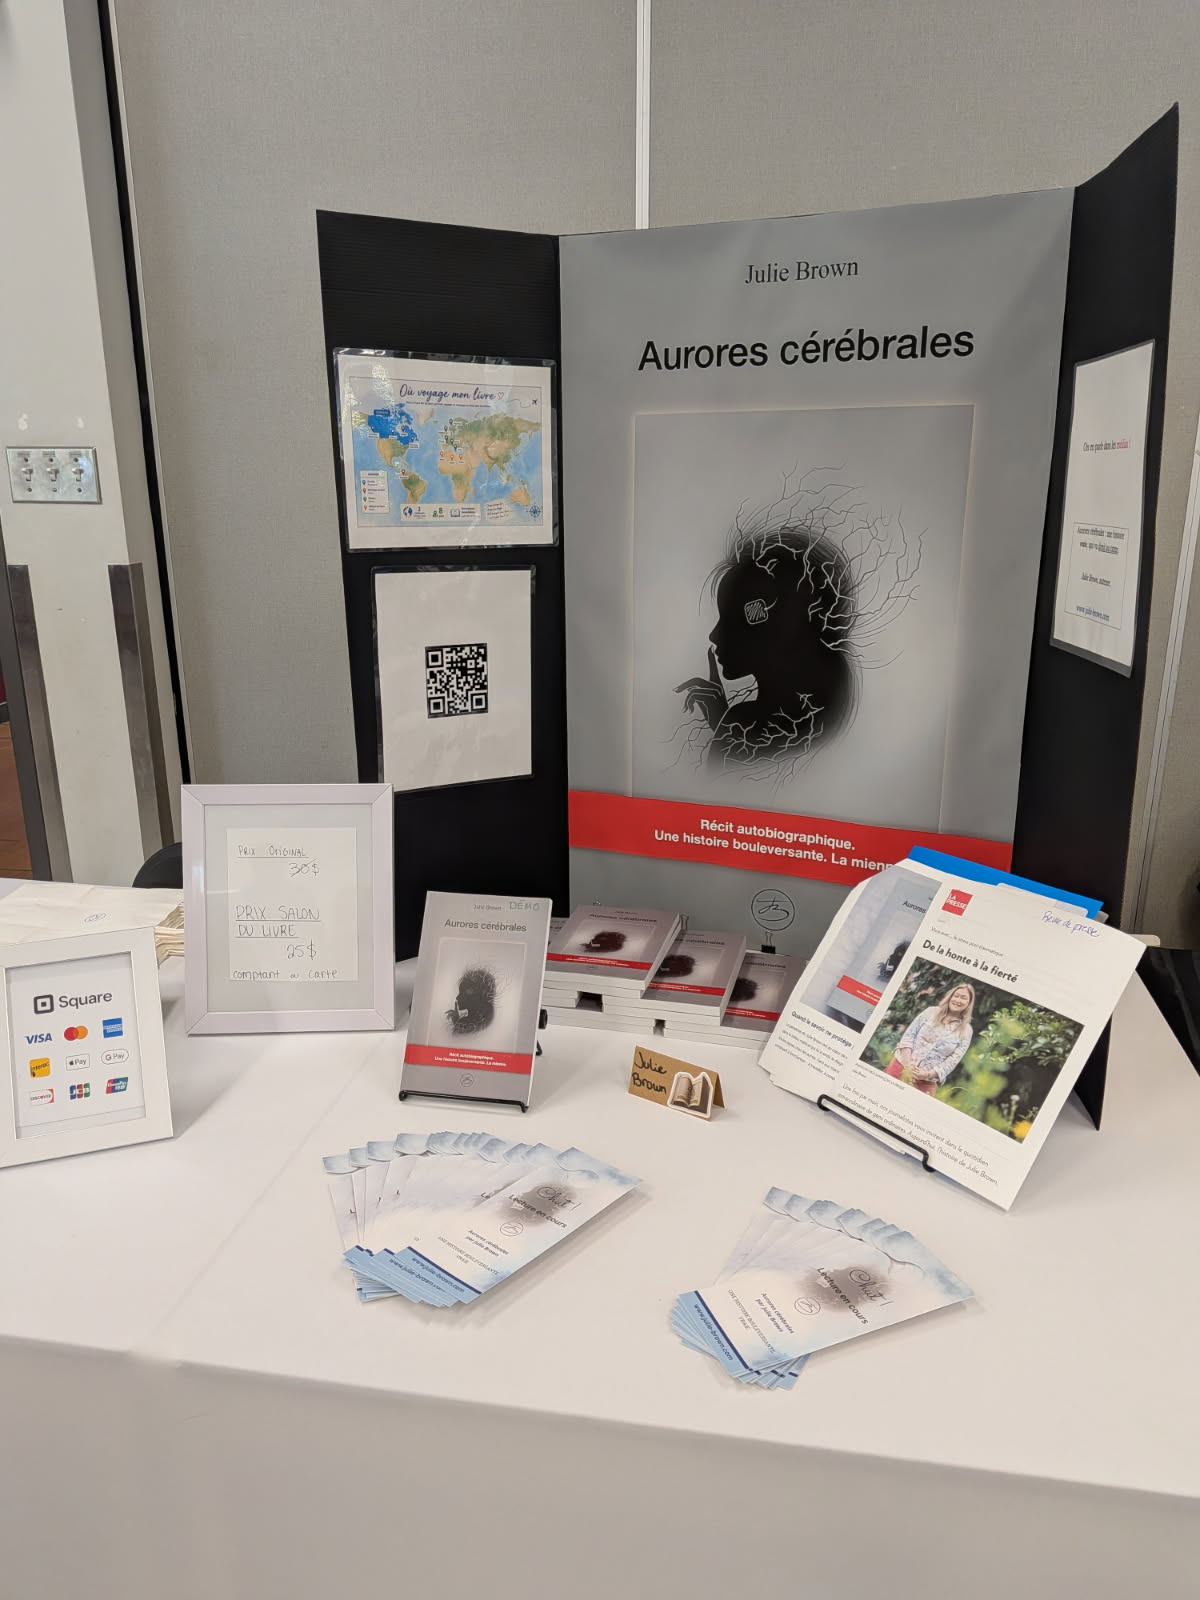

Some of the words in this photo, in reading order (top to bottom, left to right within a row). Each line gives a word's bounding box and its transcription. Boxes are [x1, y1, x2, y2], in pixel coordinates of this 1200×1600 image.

[744, 263, 790, 285] Julie
[794, 259, 859, 281] Brown
[637, 340, 770, 371] Aurores
[780, 325, 975, 366] cérébrales
[417, 389, 449, 402] voyage
[472, 387, 496, 400] livre
[700, 818, 735, 834] Récit
[736, 823, 857, 851] autobiographique.
[238, 845, 256, 856] PRIX
[654, 829, 680, 843] Une
[682, 831, 730, 849] histoire
[732, 837, 828, 863] bouleversante.
[831, 852, 848, 866] La
[851, 858, 894, 873] mienn
[236, 904, 267, 920] PRIX
[278, 905, 320, 920] SALON
[238, 924, 254, 937] DU
[262, 924, 297, 937] LIVRE
[444, 918, 479, 929] Aurores
[480, 921, 527, 932] cérébrales
[922, 939, 936, 950] De
[936, 944, 945, 954] la
[945, 948, 972, 964] honte
[972, 958, 979, 967] à
[979, 961, 989, 970] la
[990, 965, 1018, 982] fierté
[58, 992, 113, 1009] Square
[25, 1033, 53, 1044] VISA
[790, 1010, 806, 1022] Quand
[810, 1021, 825, 1032] savoir
[830, 1032, 853, 1048] protège
[74, 1058, 87, 1066] Pay
[112, 1052, 126, 1060] Pay
[634, 1051, 667, 1074] Julie
[632, 1072, 667, 1095] Brown
[887, 1107, 914, 1126] journalistes
[944, 1138, 958, 1149] dans
[962, 1147, 990, 1167] quotidien
[966, 1162, 980, 1174] Julie
[508, 1194, 538, 1216] Lecture
[536, 1207, 548, 1219] en
[545, 1211, 568, 1229] cours
[817, 1266, 842, 1295] Lecture
[840, 1293, 851, 1307] en
[849, 1305, 869, 1325] cours
[693, 1303, 734, 1361] www.julie-brown.com
